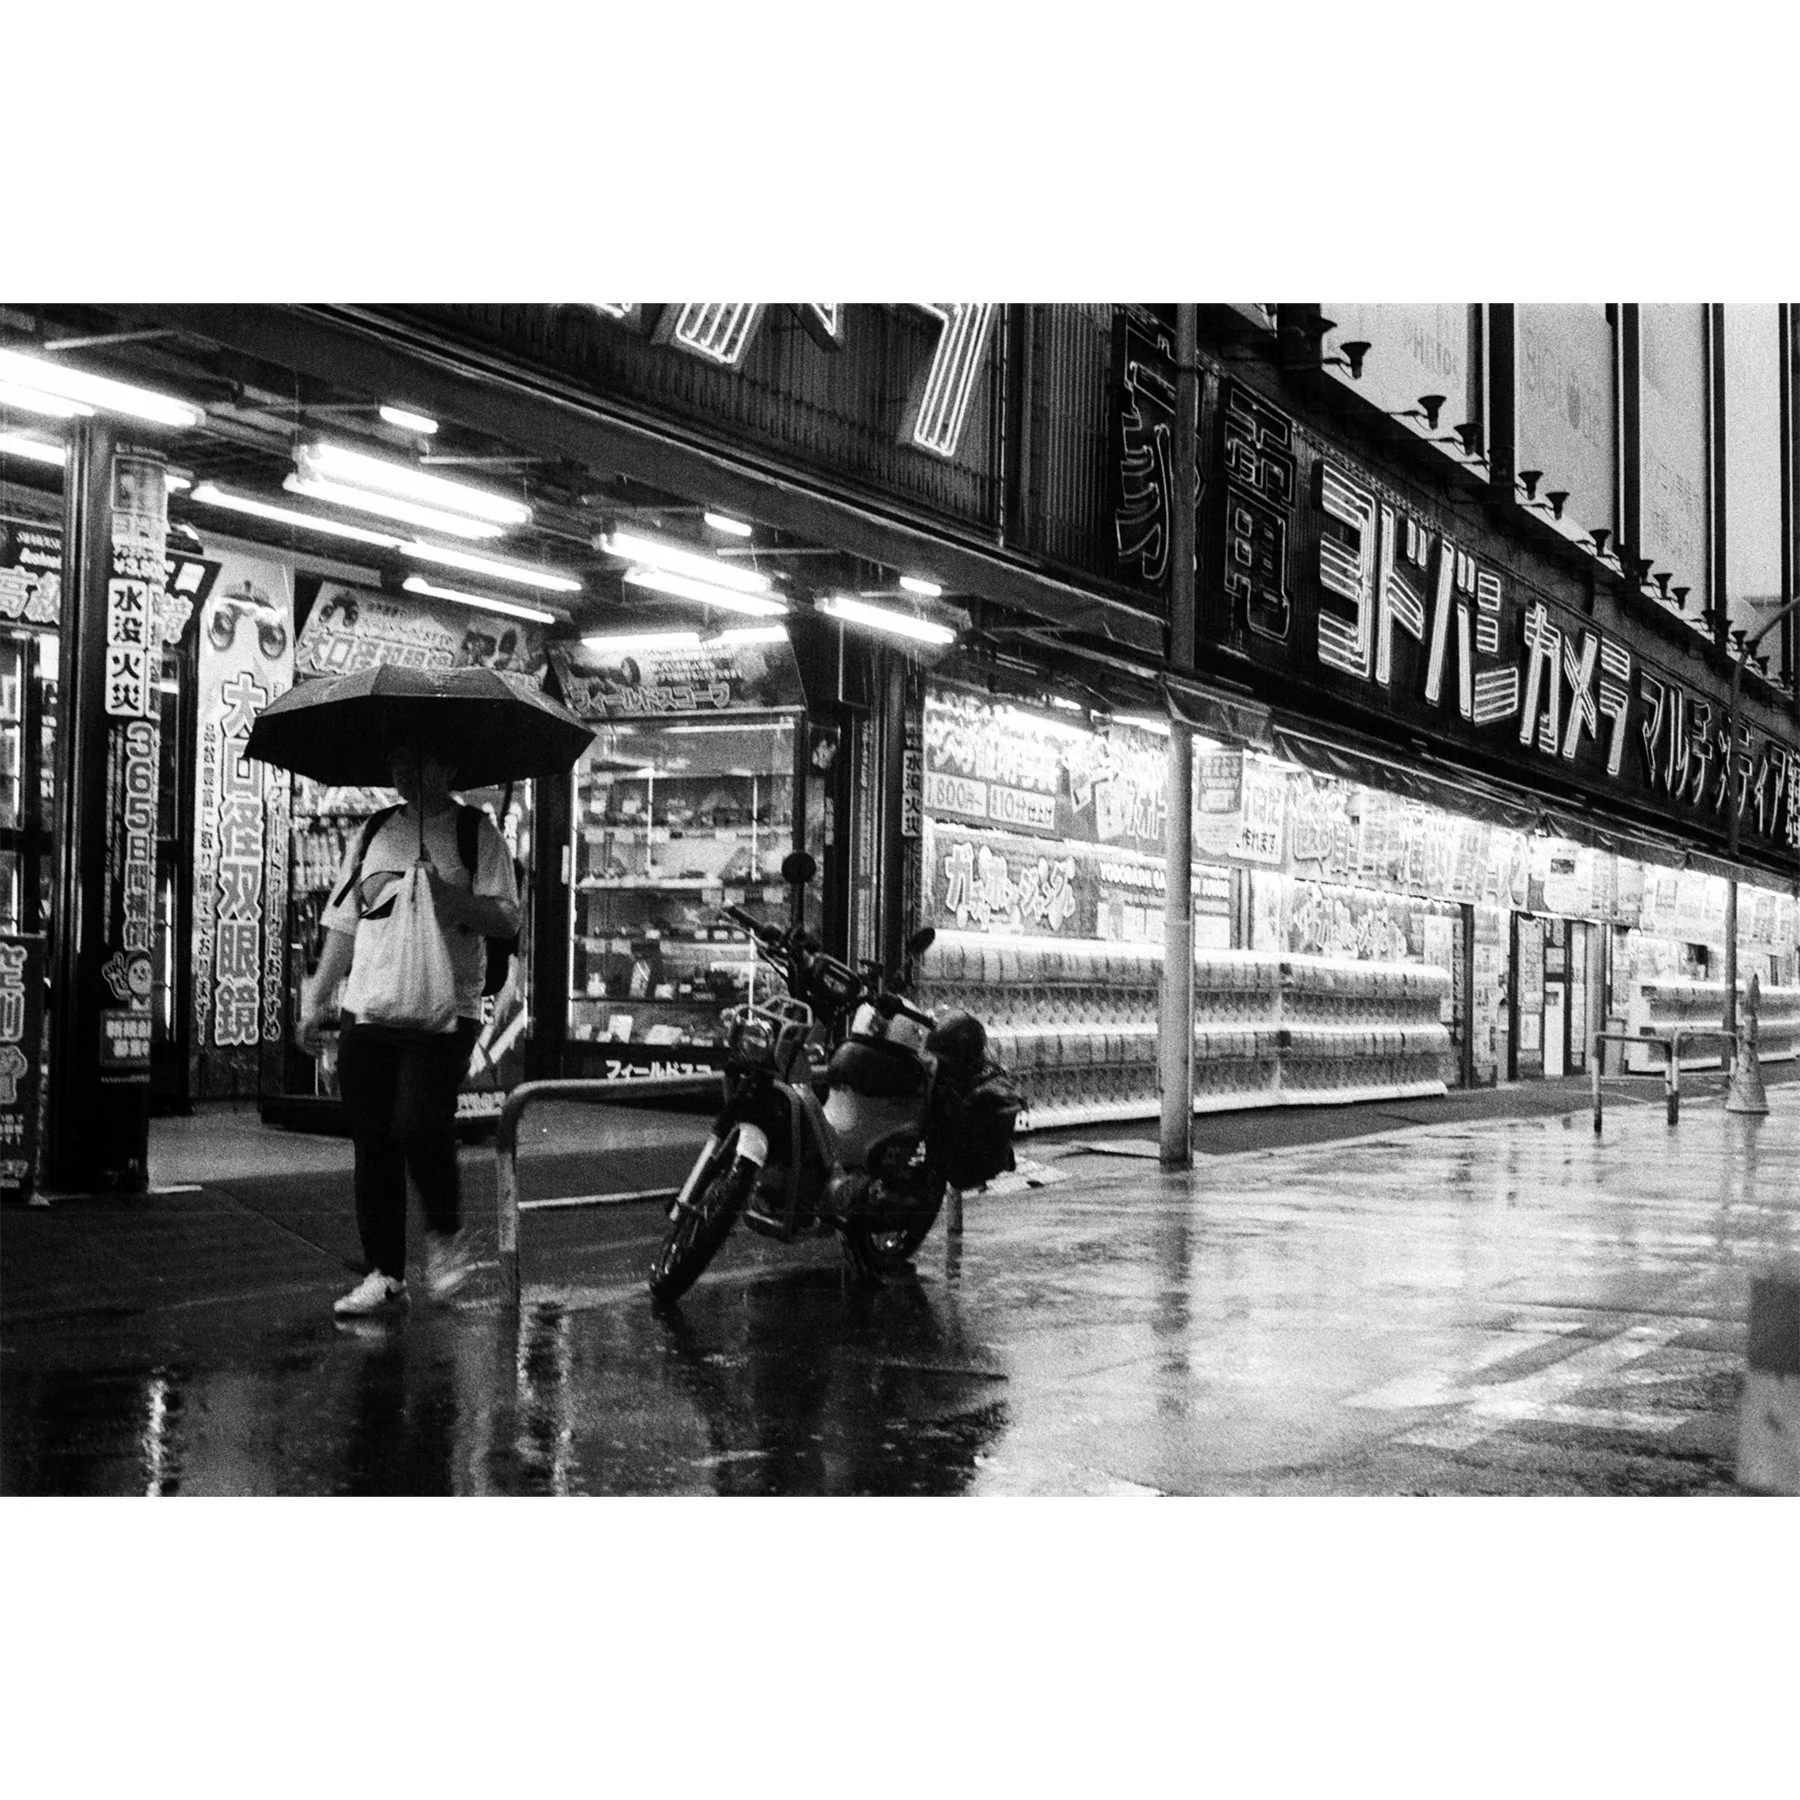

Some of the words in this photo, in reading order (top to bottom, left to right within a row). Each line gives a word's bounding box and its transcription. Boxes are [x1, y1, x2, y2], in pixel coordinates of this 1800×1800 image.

[1317, 462, 1630, 776] ヨドバシカメラ
[213, 672, 268, 1046] 大口径双眼鏡
